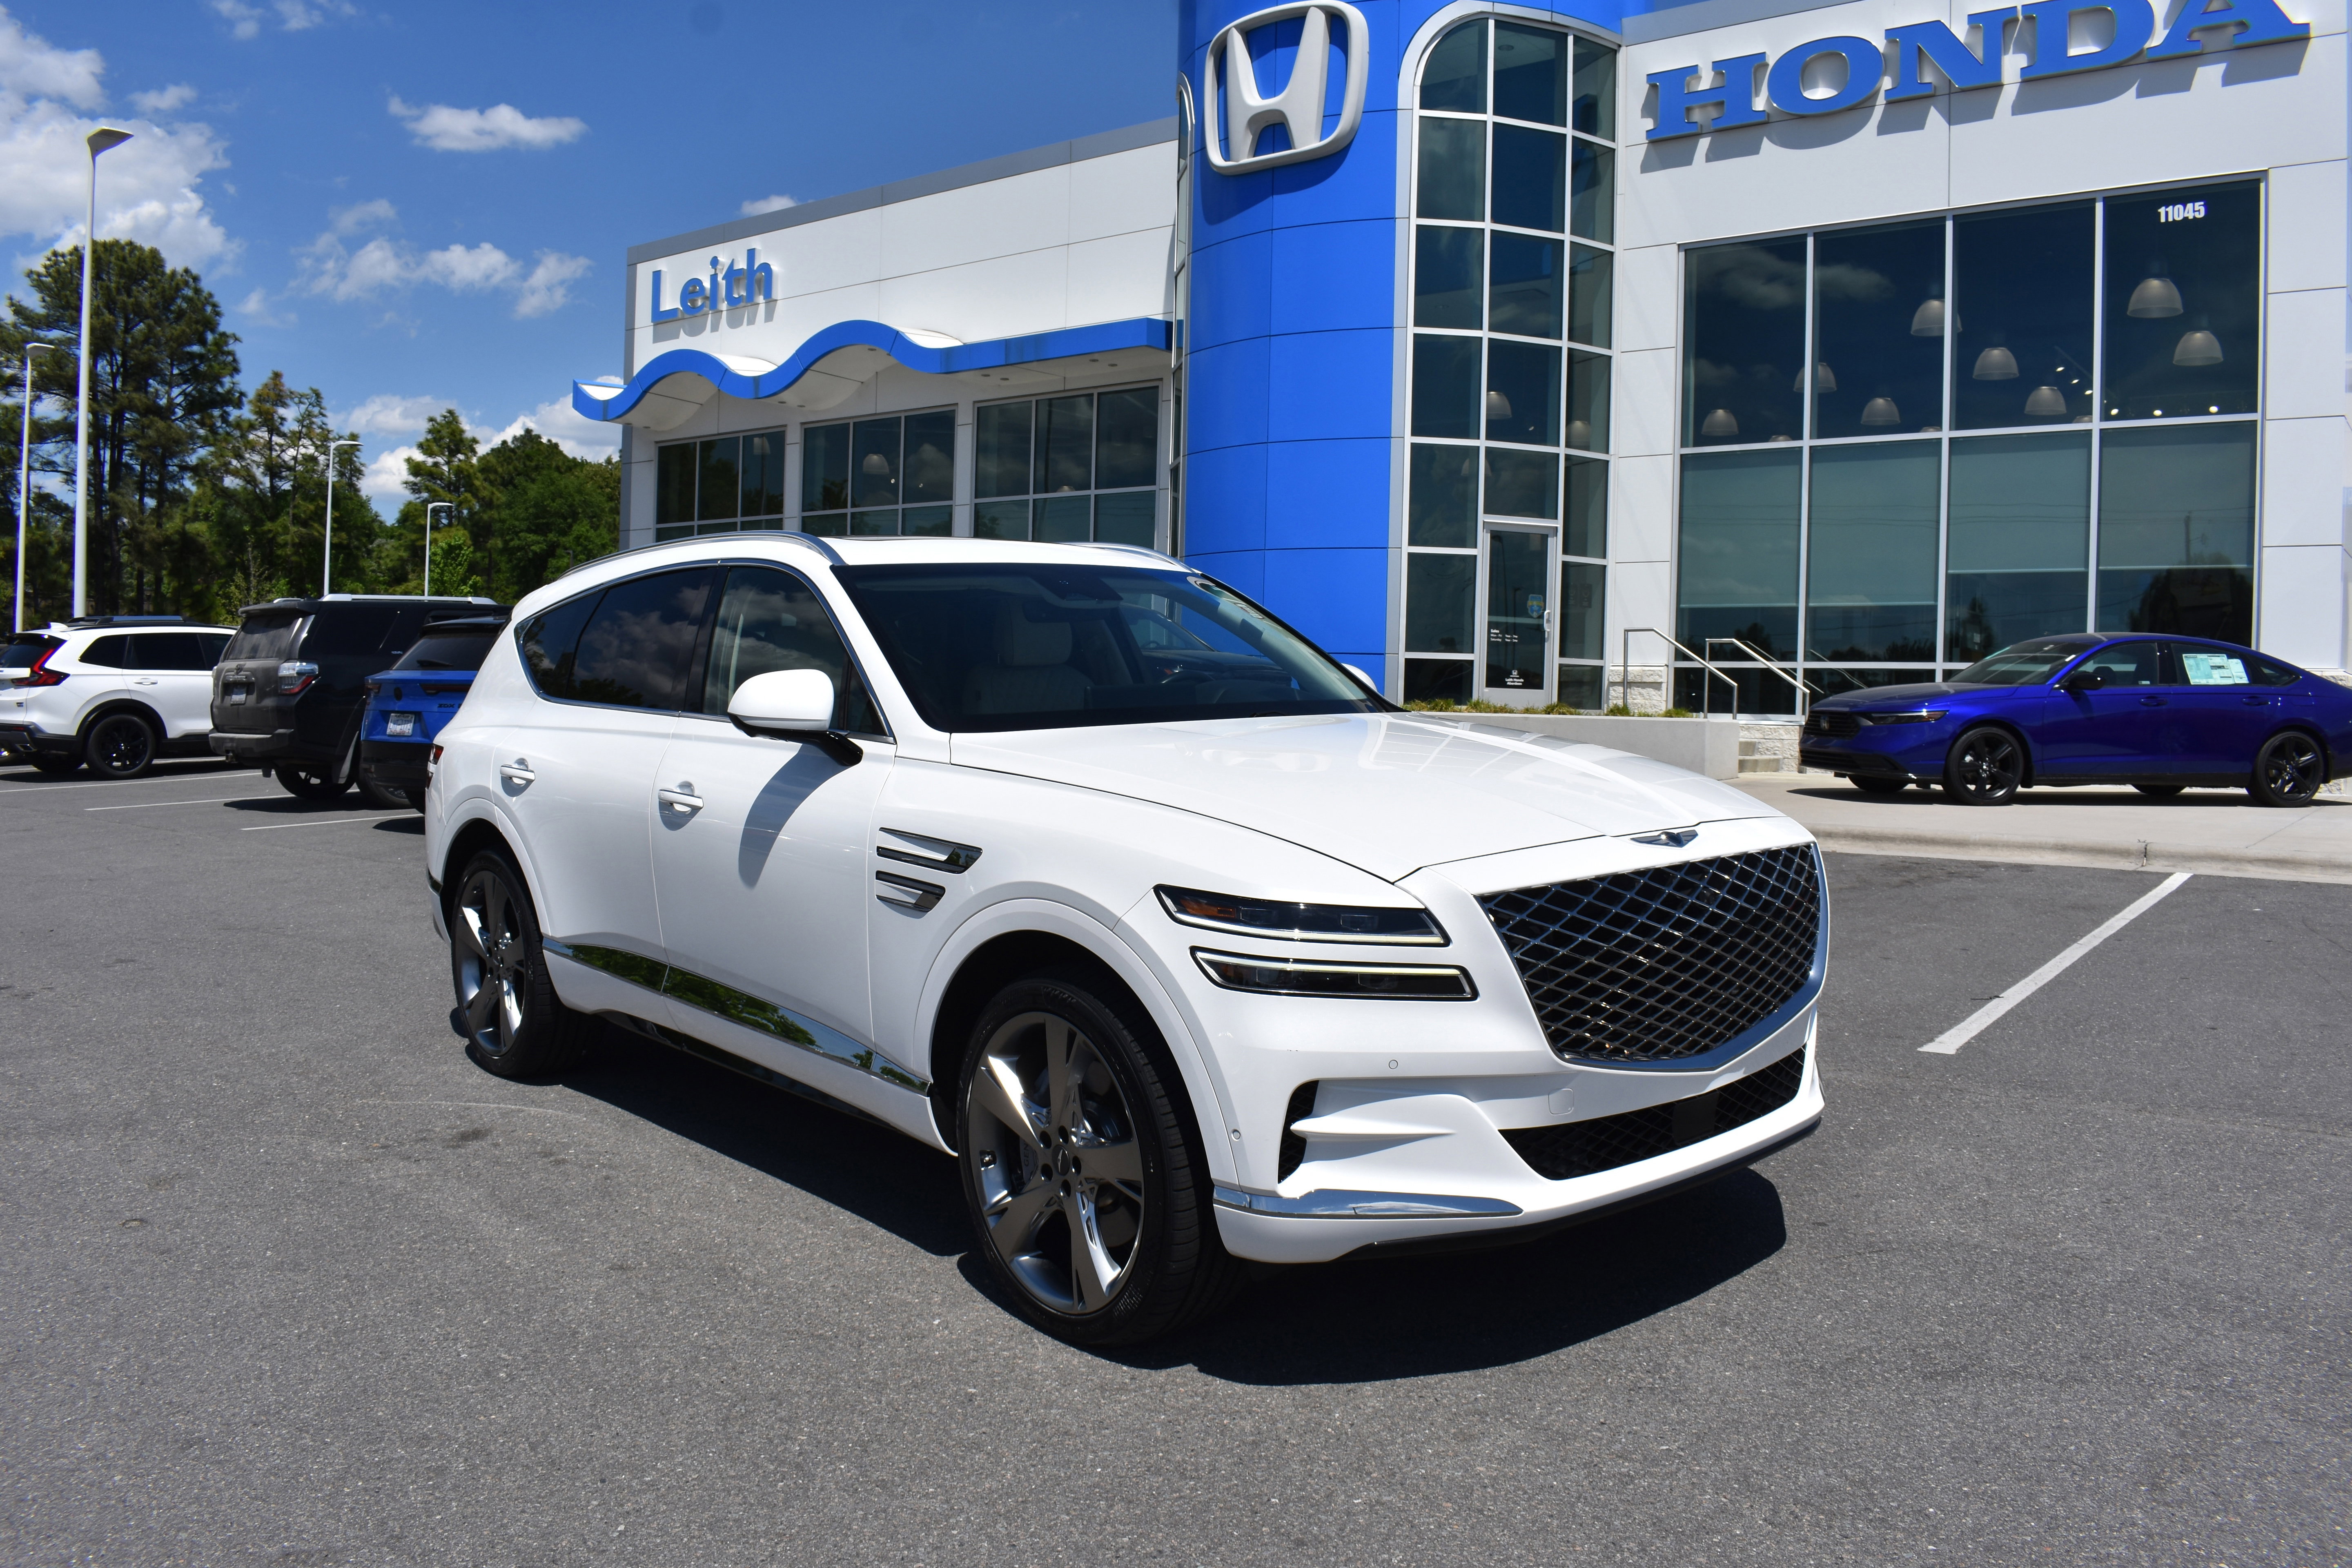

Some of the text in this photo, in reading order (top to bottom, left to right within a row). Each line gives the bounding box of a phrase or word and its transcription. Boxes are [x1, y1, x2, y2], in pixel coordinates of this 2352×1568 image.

[1646, 0, 2310, 140] HONDA
[2158, 202, 2205, 223] 11045
[651, 247, 774, 323] Leith
